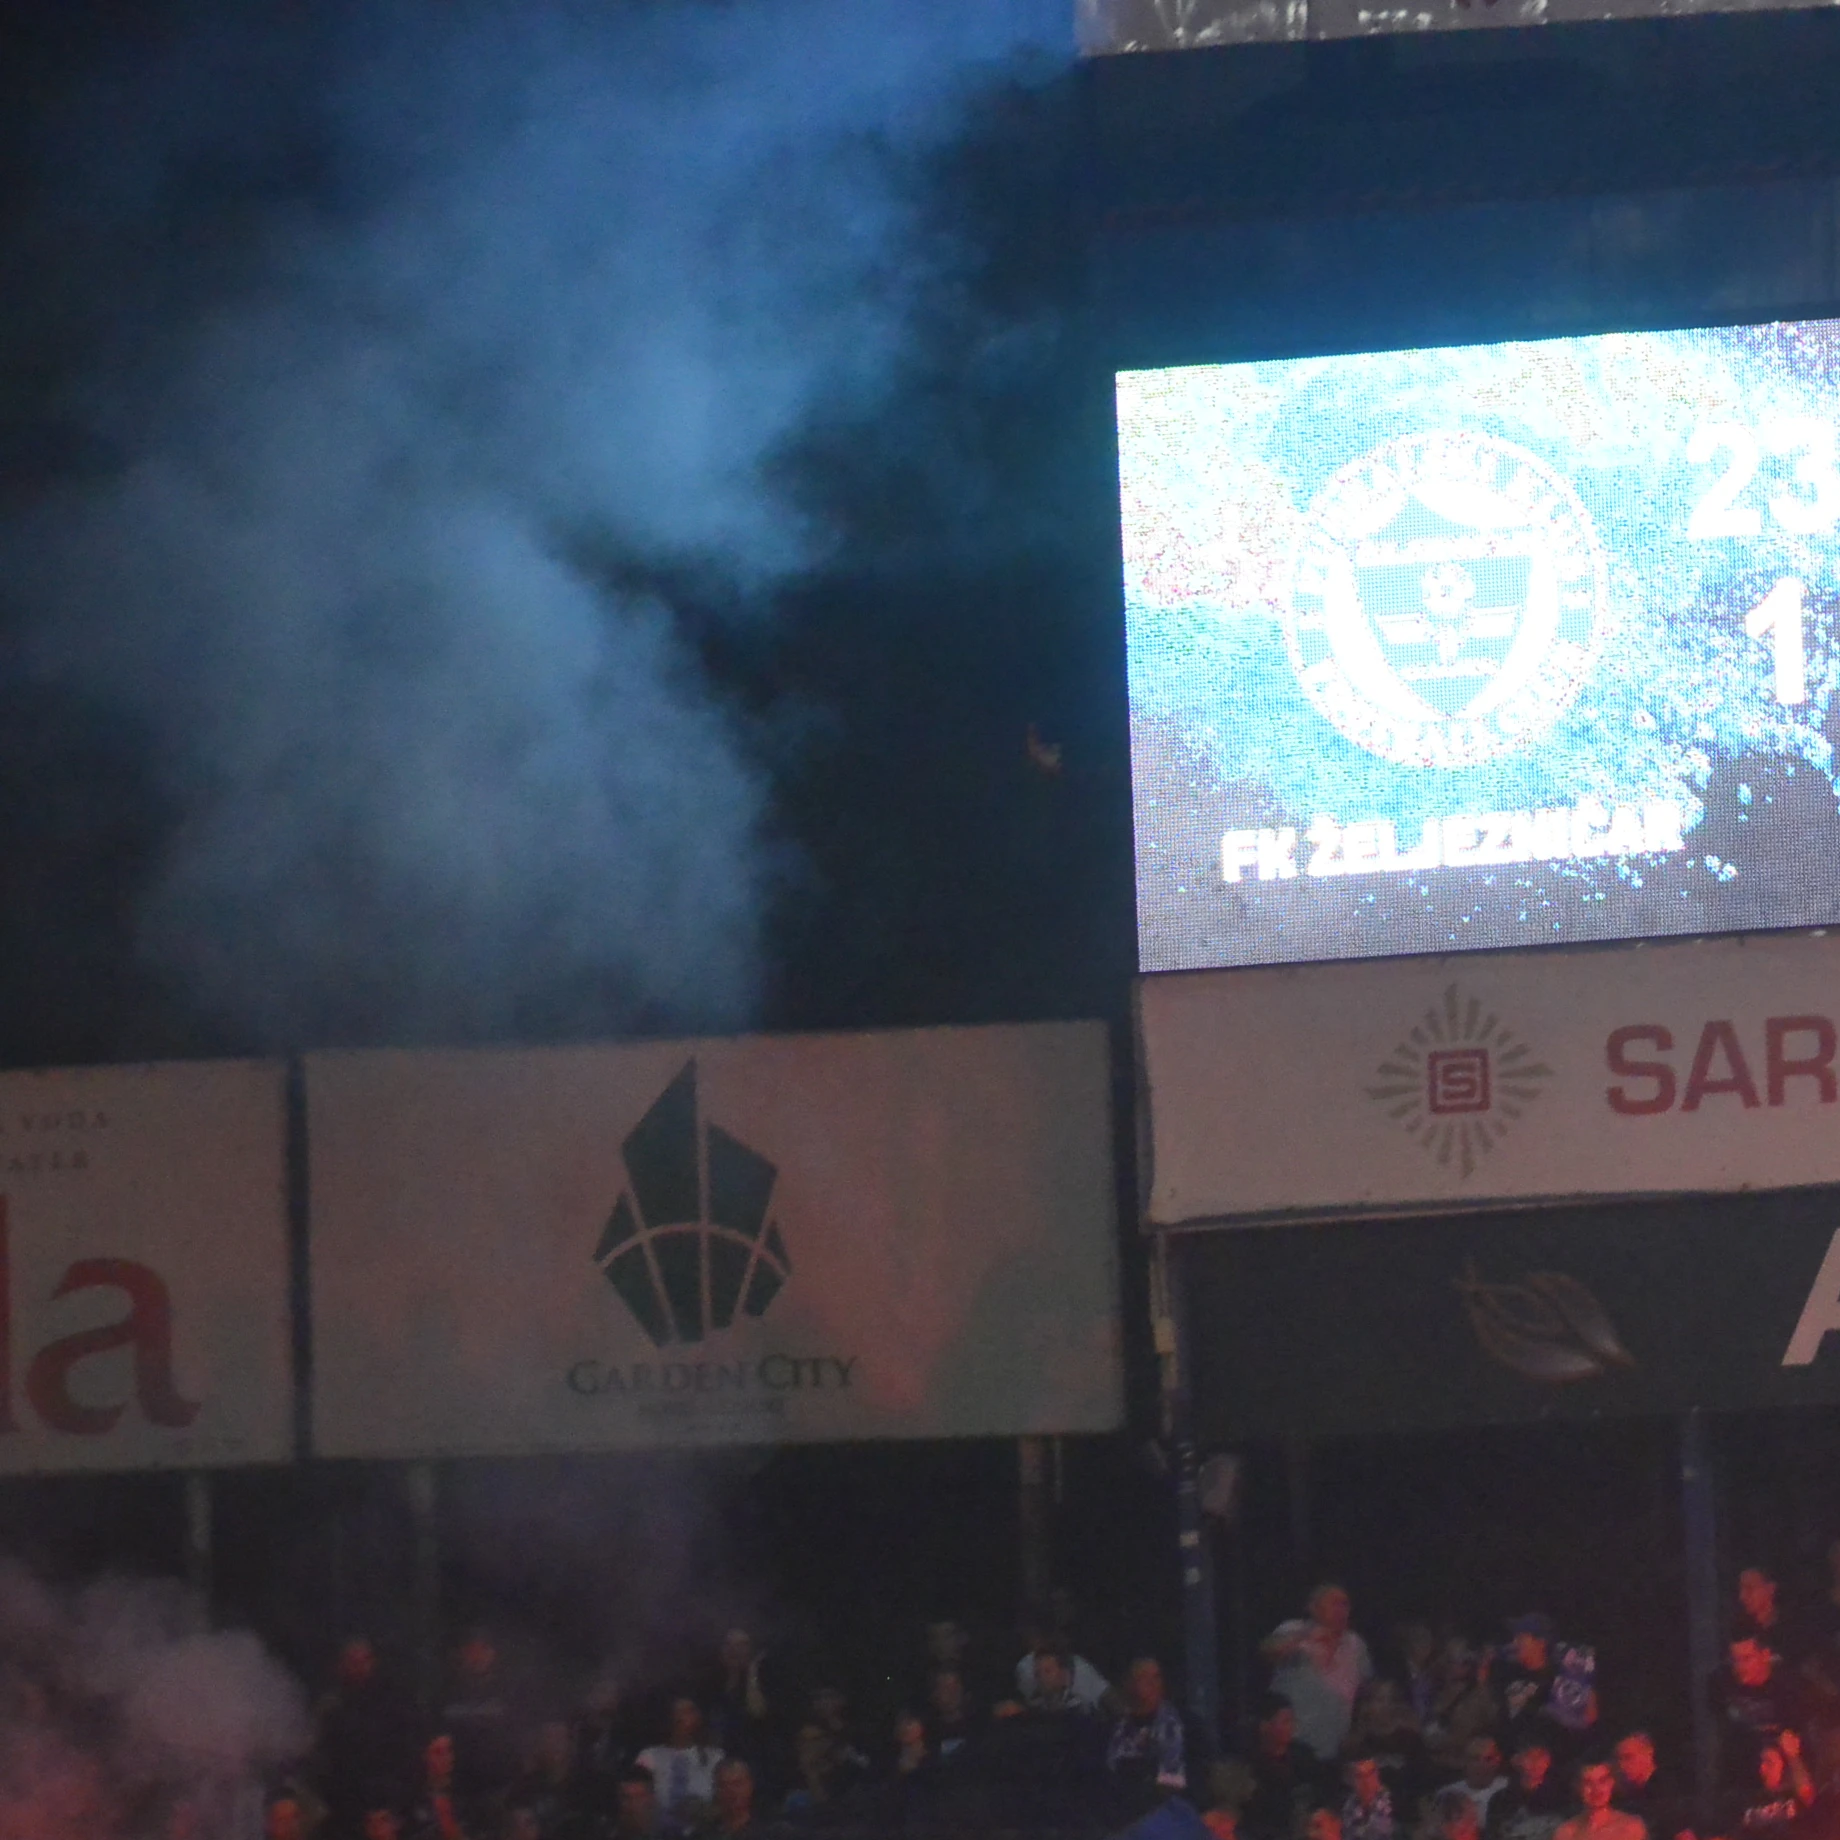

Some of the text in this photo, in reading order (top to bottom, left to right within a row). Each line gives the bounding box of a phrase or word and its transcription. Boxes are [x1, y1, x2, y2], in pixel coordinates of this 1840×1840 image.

[1221, 828, 1298, 884] FK
[567, 1353, 858, 1396] GARDEN CITY
